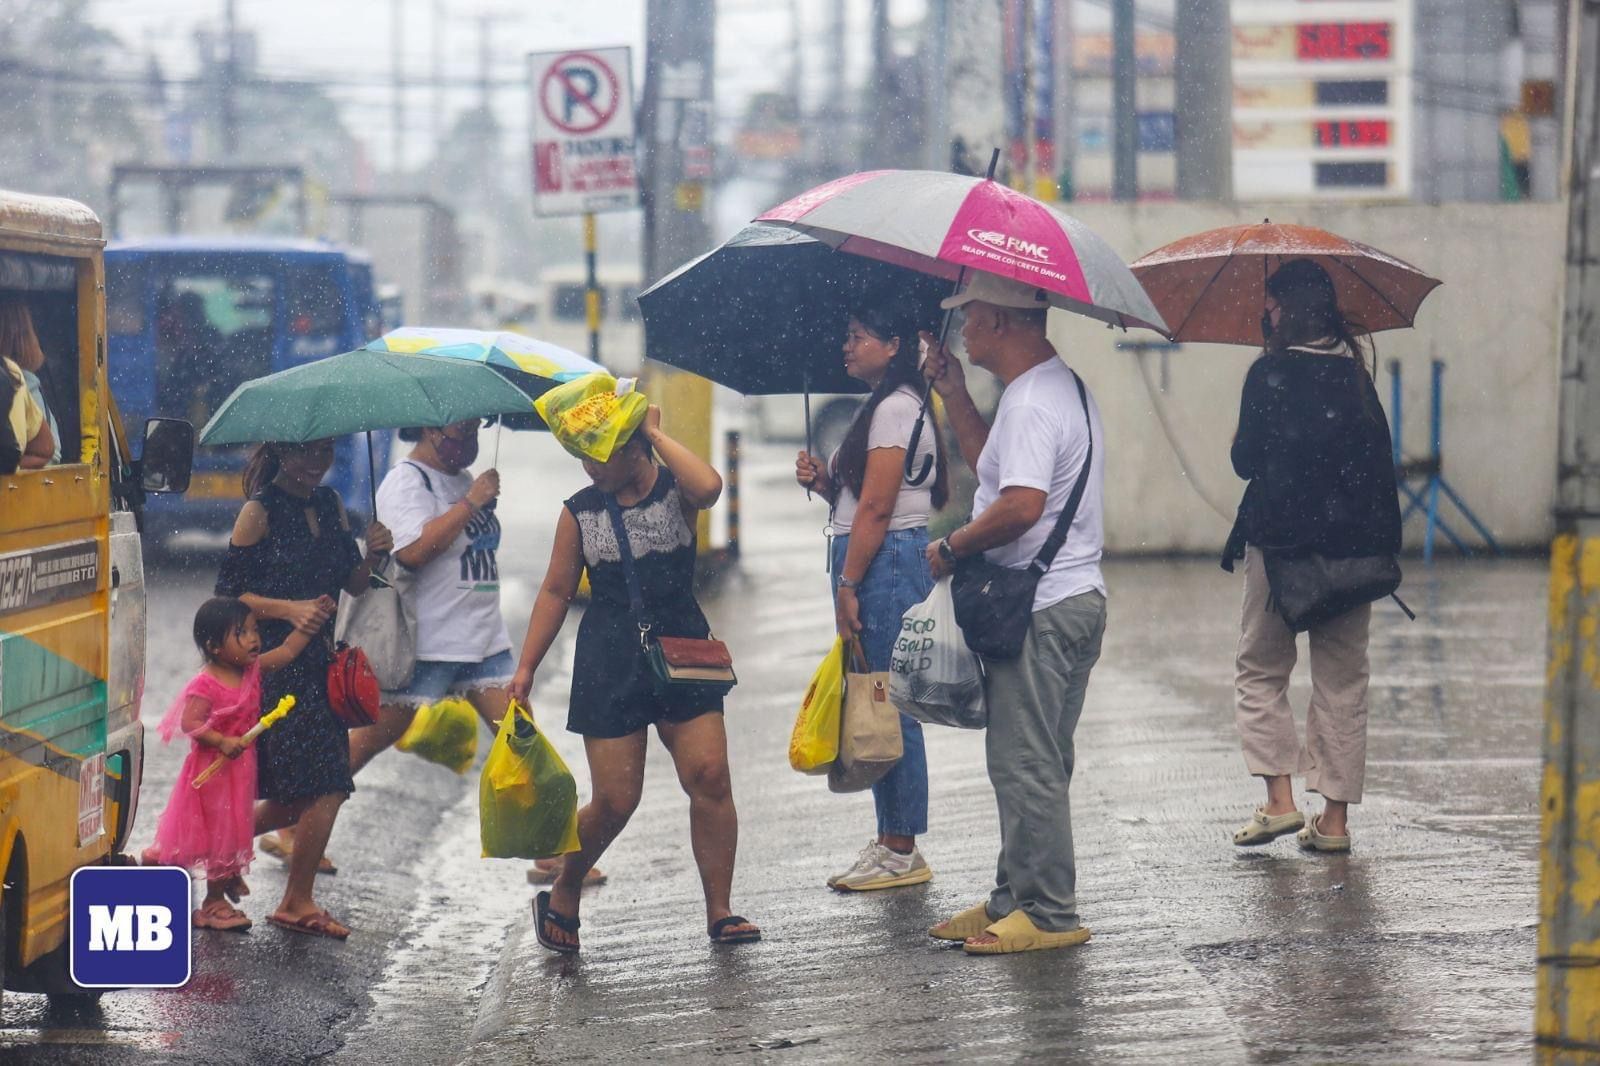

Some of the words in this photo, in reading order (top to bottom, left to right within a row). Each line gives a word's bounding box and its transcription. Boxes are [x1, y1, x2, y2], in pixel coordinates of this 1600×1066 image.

[1007, 236, 1048, 259] RMC
[962, 245, 986, 256] READY
[986, 252, 1001, 262] MIX
[1001, 256, 1039, 273] CONCRETE
[1040, 267, 1067, 281] DAVAO
